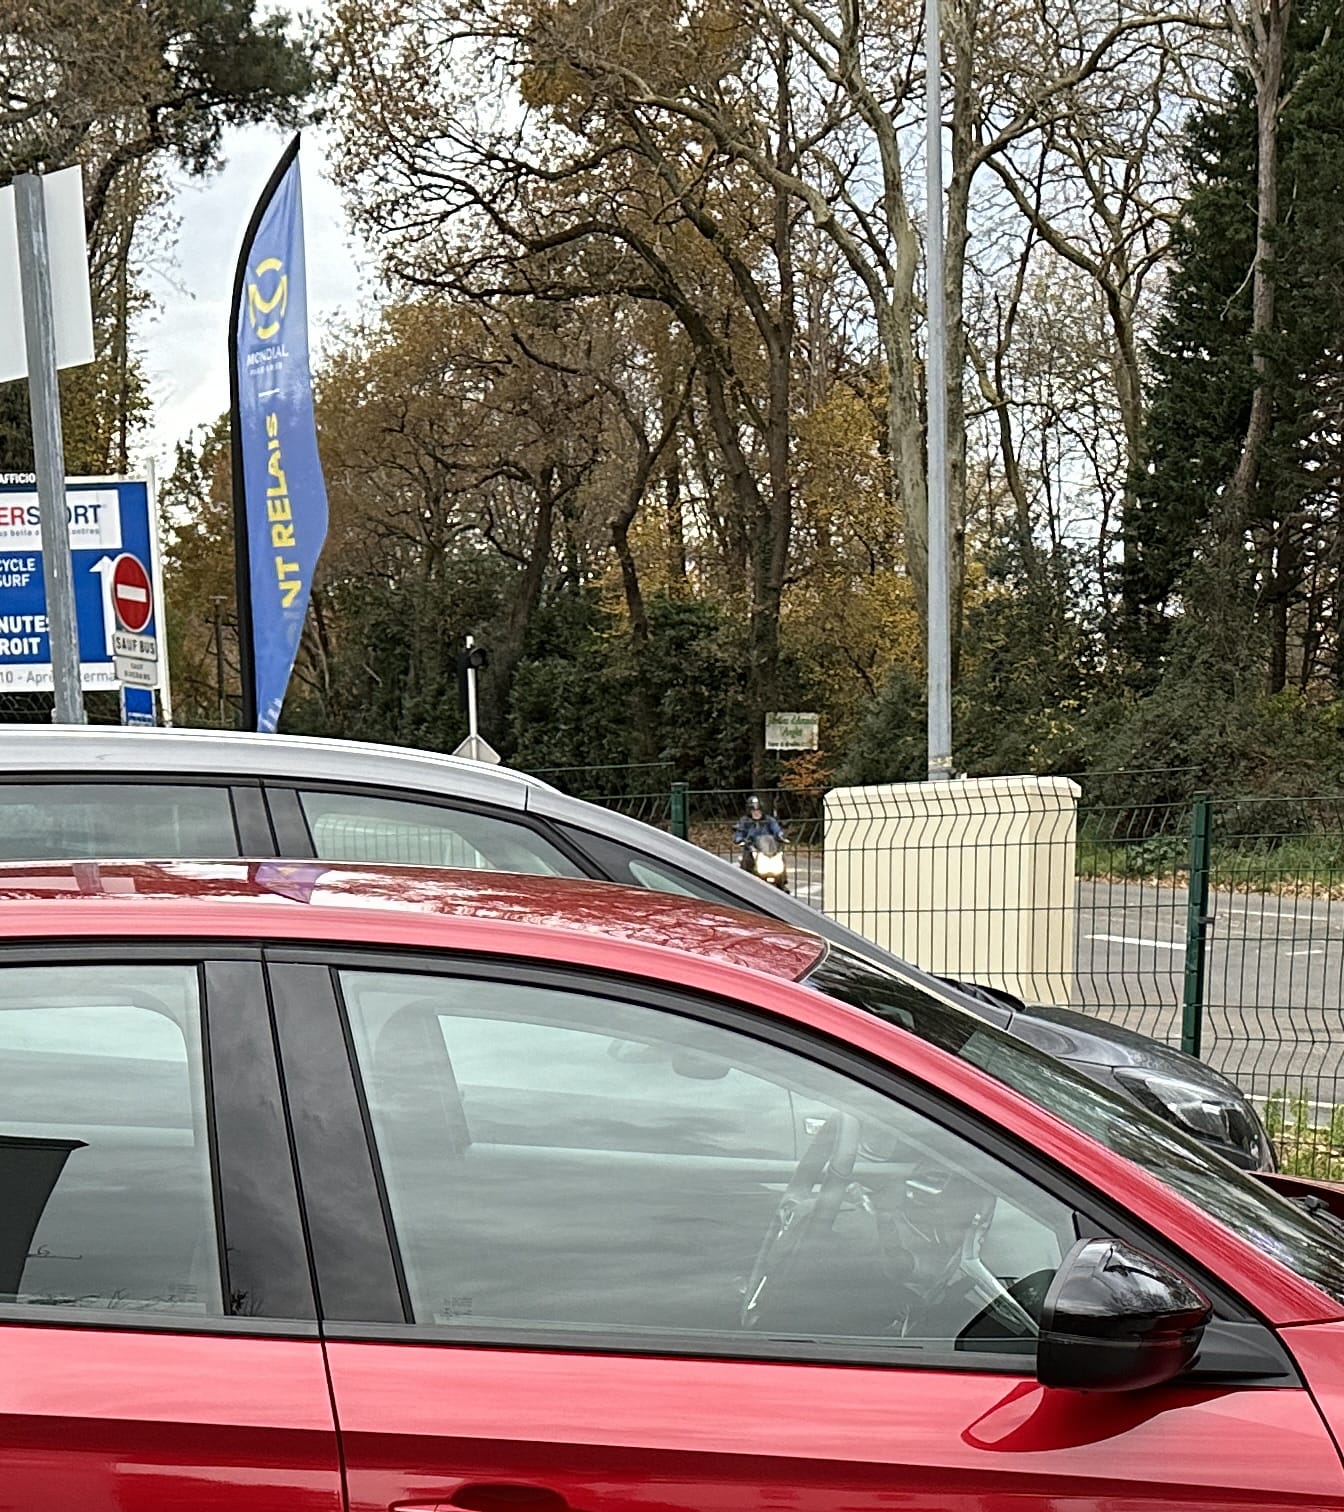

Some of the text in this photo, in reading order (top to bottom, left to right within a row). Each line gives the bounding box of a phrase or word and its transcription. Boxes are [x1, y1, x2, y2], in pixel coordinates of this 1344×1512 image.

[247, 344, 288, 366] MONDIAL
[265, 412, 296, 547] RELAIS
[116, 636, 155, 655] SAUF BUS
